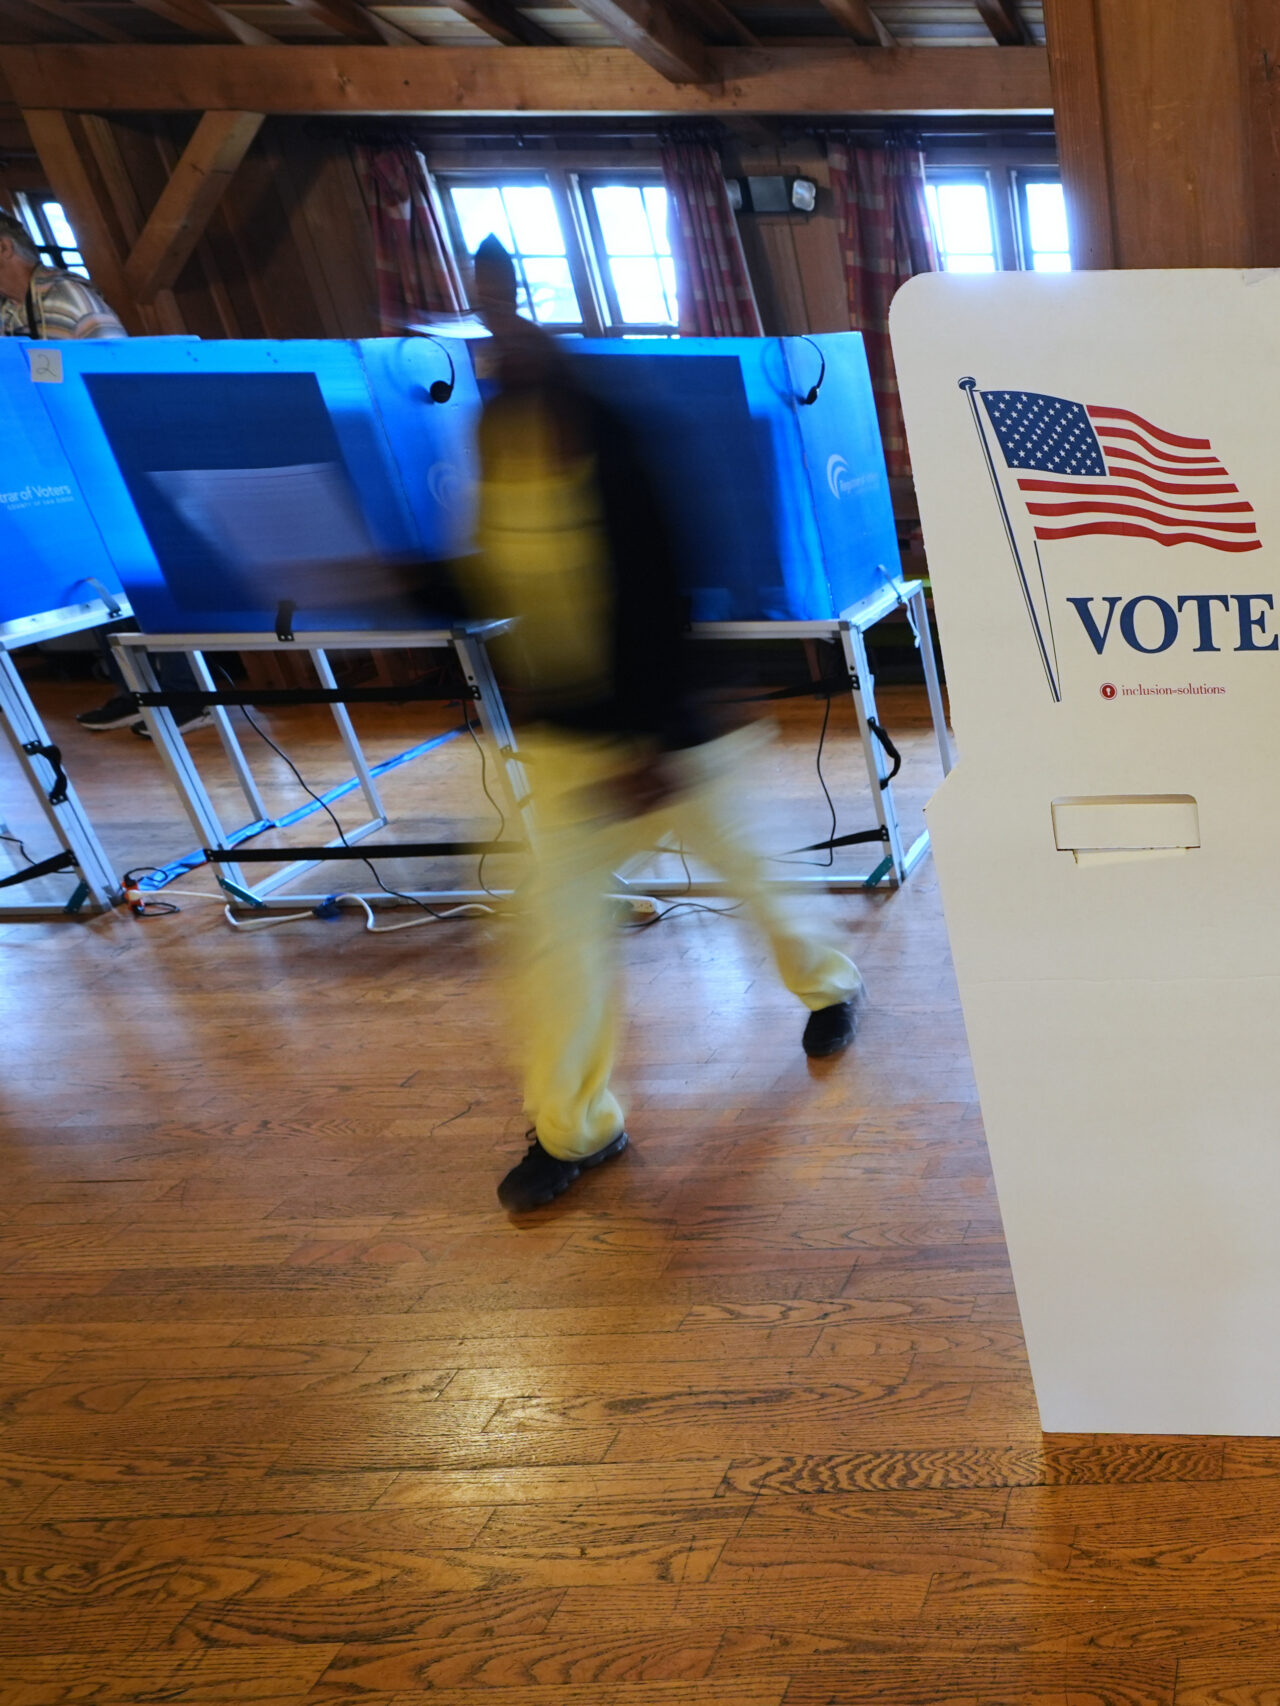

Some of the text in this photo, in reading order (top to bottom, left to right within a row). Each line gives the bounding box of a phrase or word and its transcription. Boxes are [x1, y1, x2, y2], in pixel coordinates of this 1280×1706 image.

[36, 353, 57, 376] 2
[20, 485, 32, 500] of
[32, 485, 71, 497] Voters
[1067, 594, 1280, 656] VOTE
